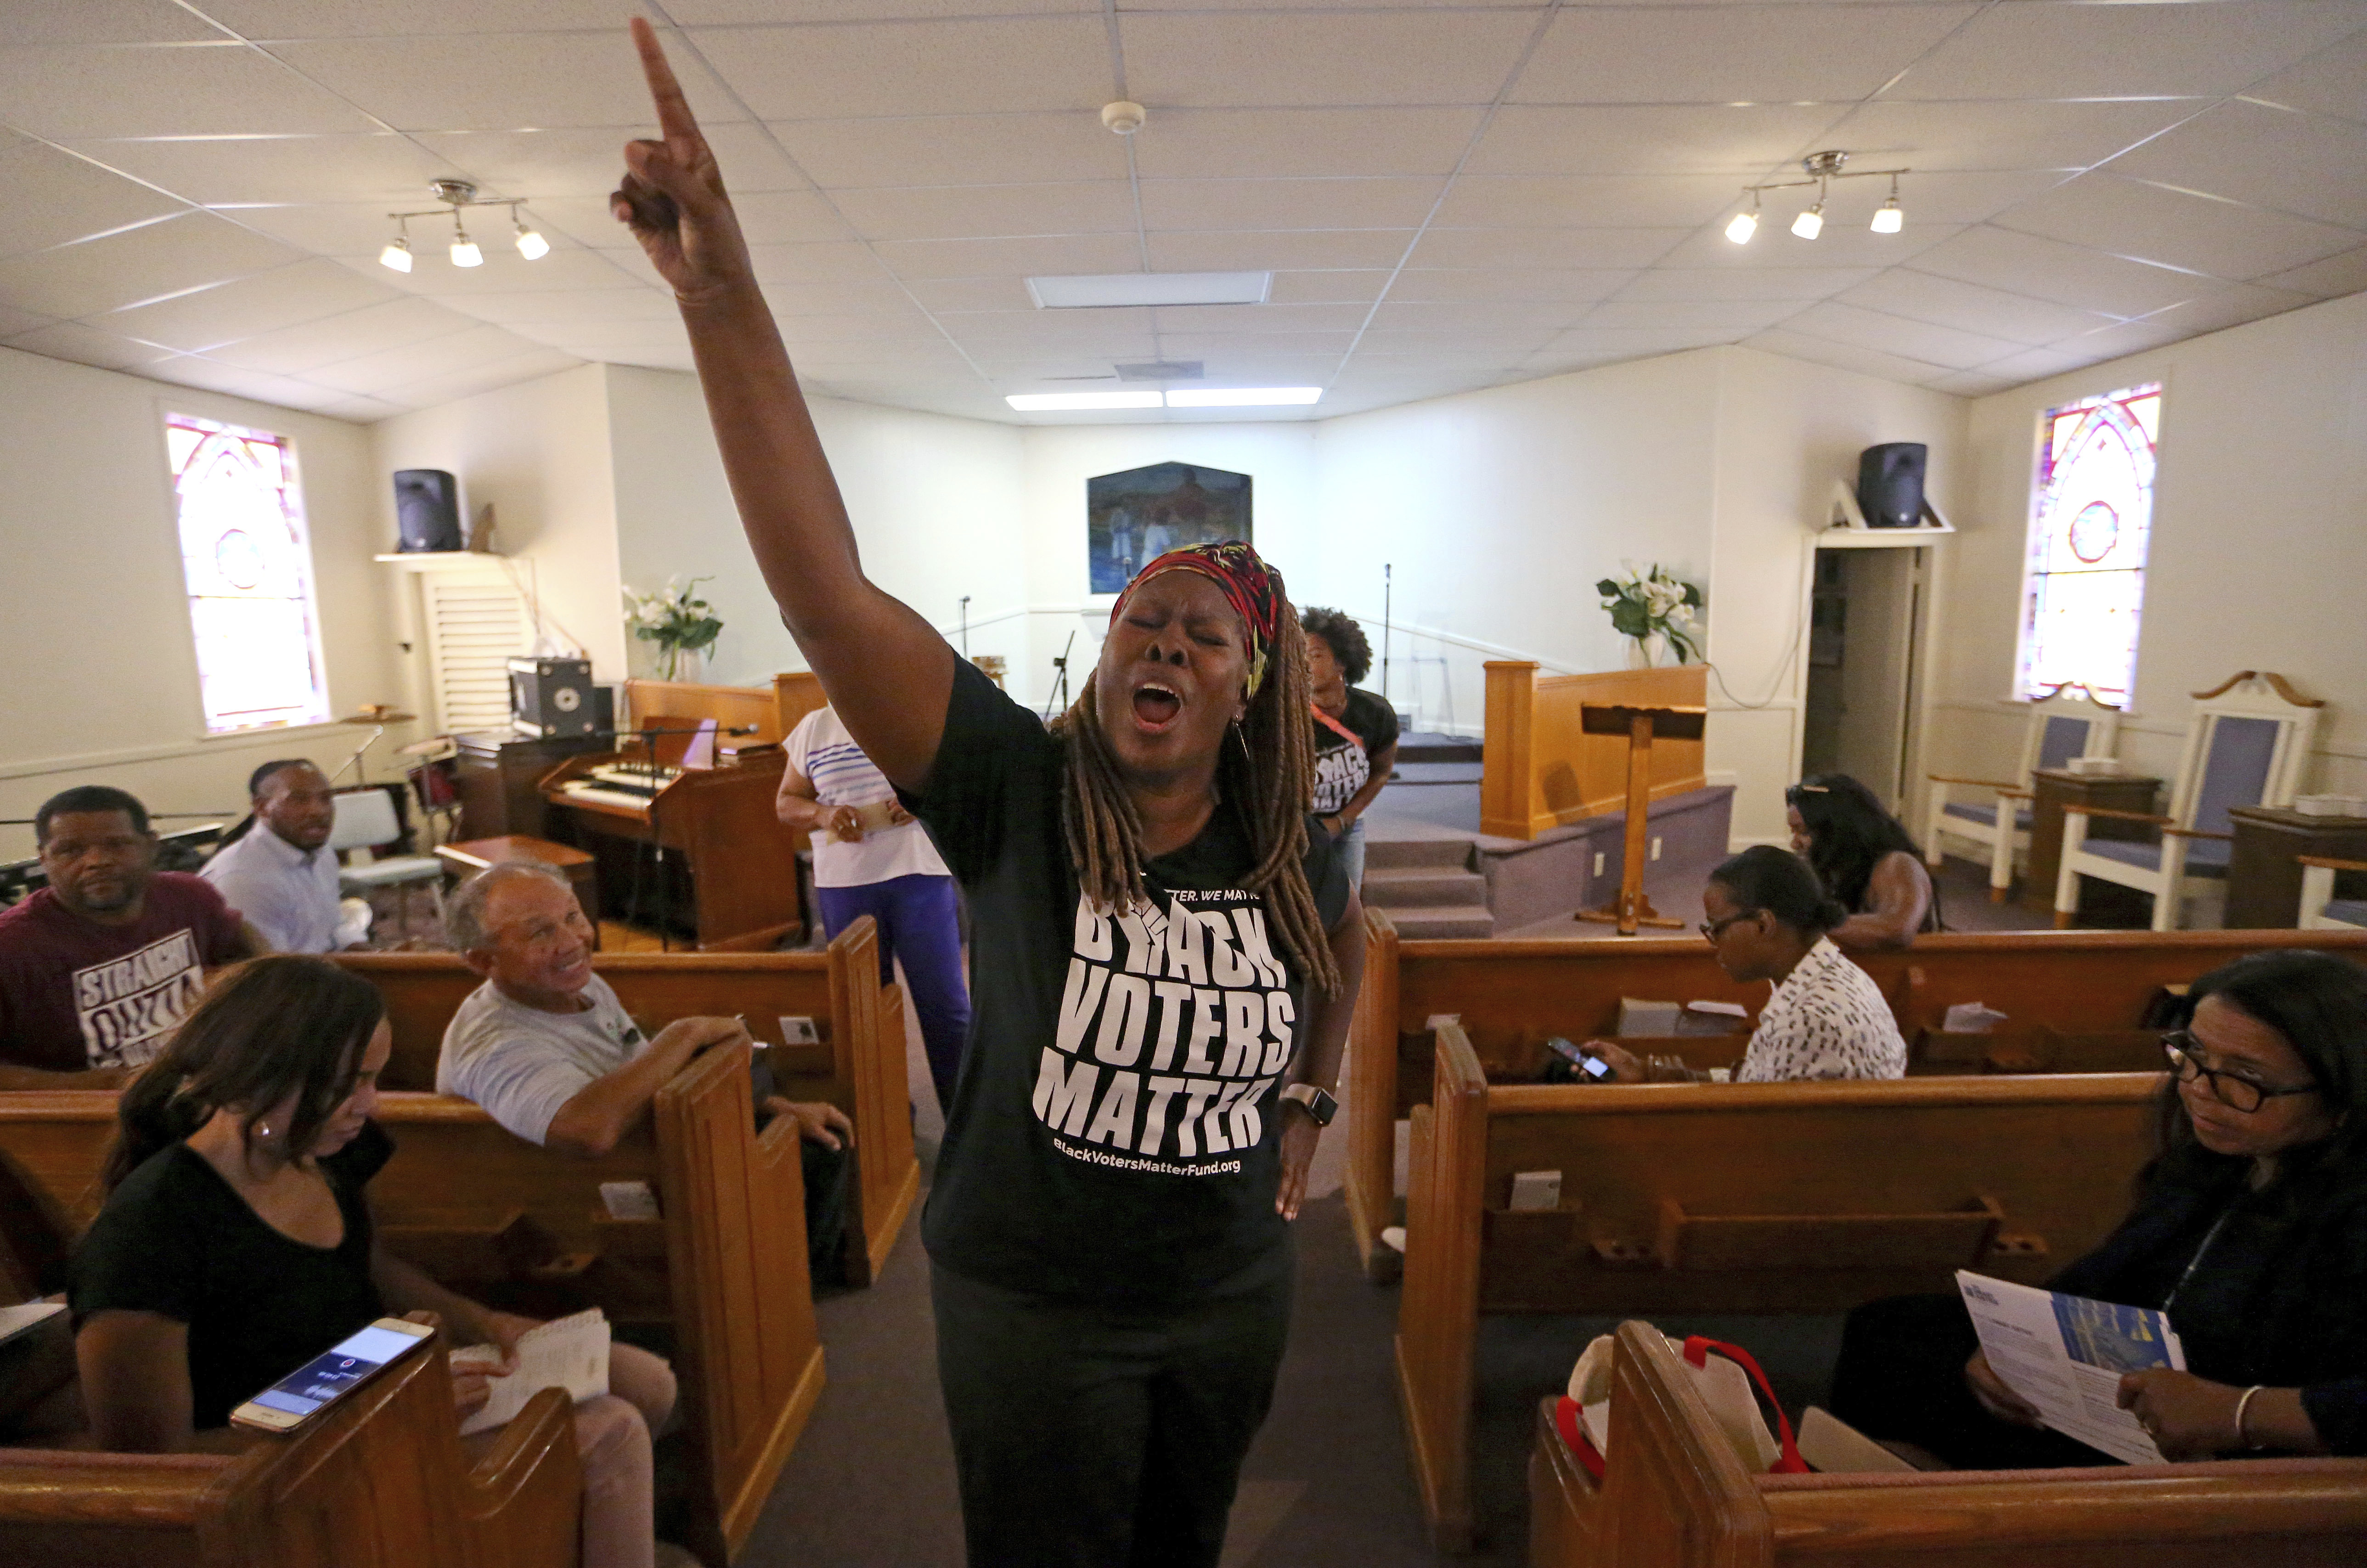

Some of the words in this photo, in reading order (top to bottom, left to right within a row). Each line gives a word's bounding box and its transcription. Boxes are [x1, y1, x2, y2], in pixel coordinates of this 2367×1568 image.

[1164, 889, 1198, 902] TER.
[1201, 890, 1222, 901] WE
[1056, 957, 1295, 1077] VOTERS
[1032, 1046, 1276, 1157] MATTER
[1054, 1138, 1241, 1177] BlackVotersMatterFund.org
